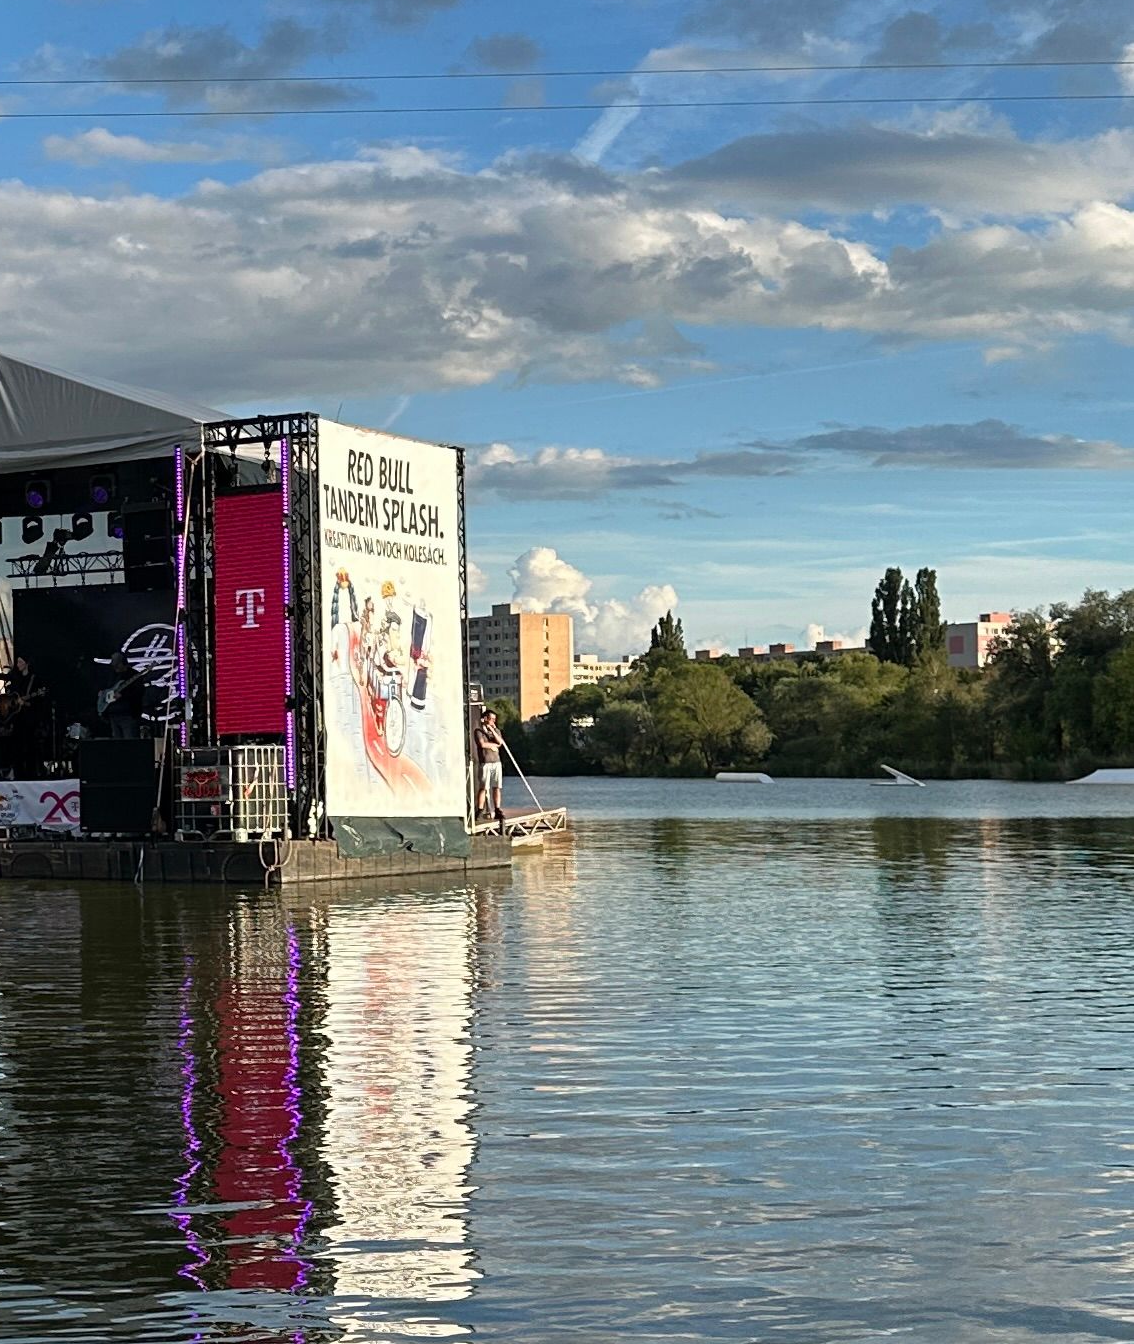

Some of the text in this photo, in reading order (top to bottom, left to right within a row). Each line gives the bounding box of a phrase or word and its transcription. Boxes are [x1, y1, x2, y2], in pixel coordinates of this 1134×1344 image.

[348, 449, 413, 494] RED BULL
[323, 484, 444, 539] TANDEM SPLASH.
[363, 537, 375, 556] NA
[376, 538, 402, 561] DVOCH
[236, 588, 265, 629] T
